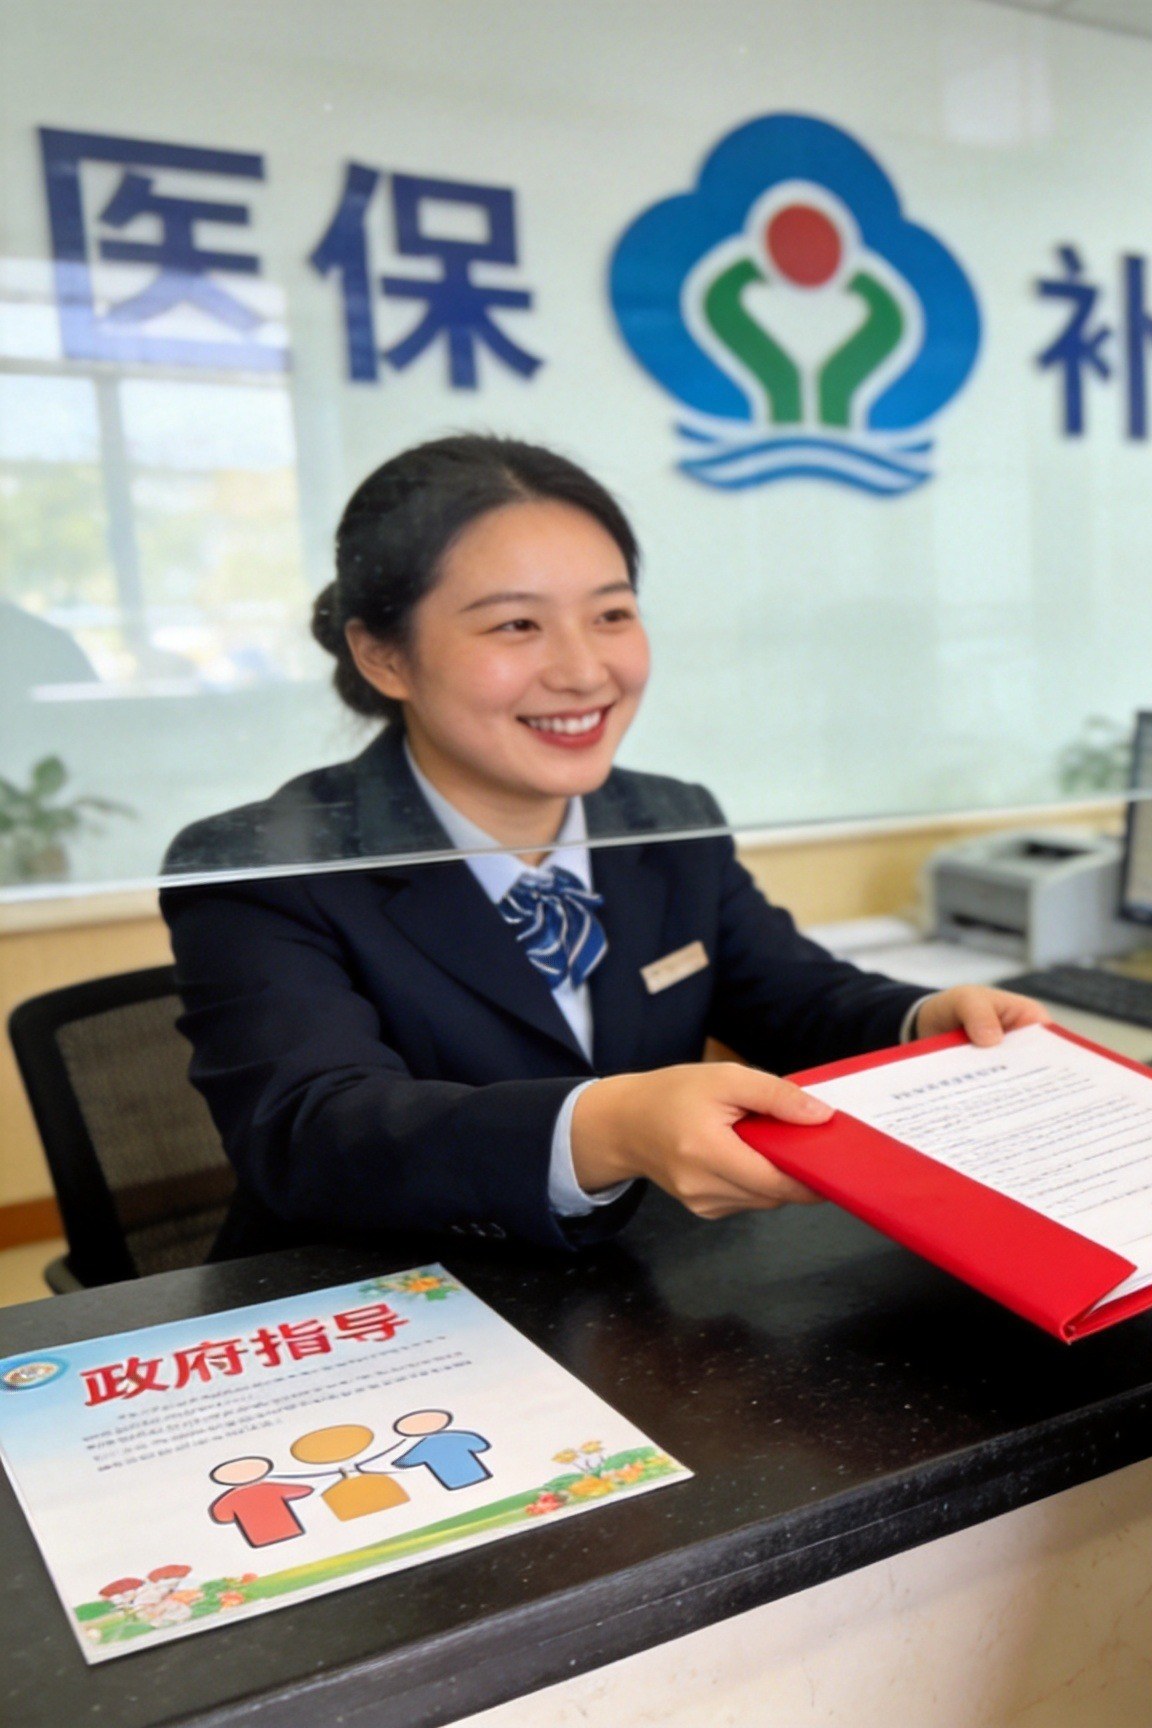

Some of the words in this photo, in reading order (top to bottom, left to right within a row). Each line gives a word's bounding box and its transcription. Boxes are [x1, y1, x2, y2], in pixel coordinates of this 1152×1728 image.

[36, 126, 545, 391] 医保
[80, 1302, 409, 1407] 政府指导
